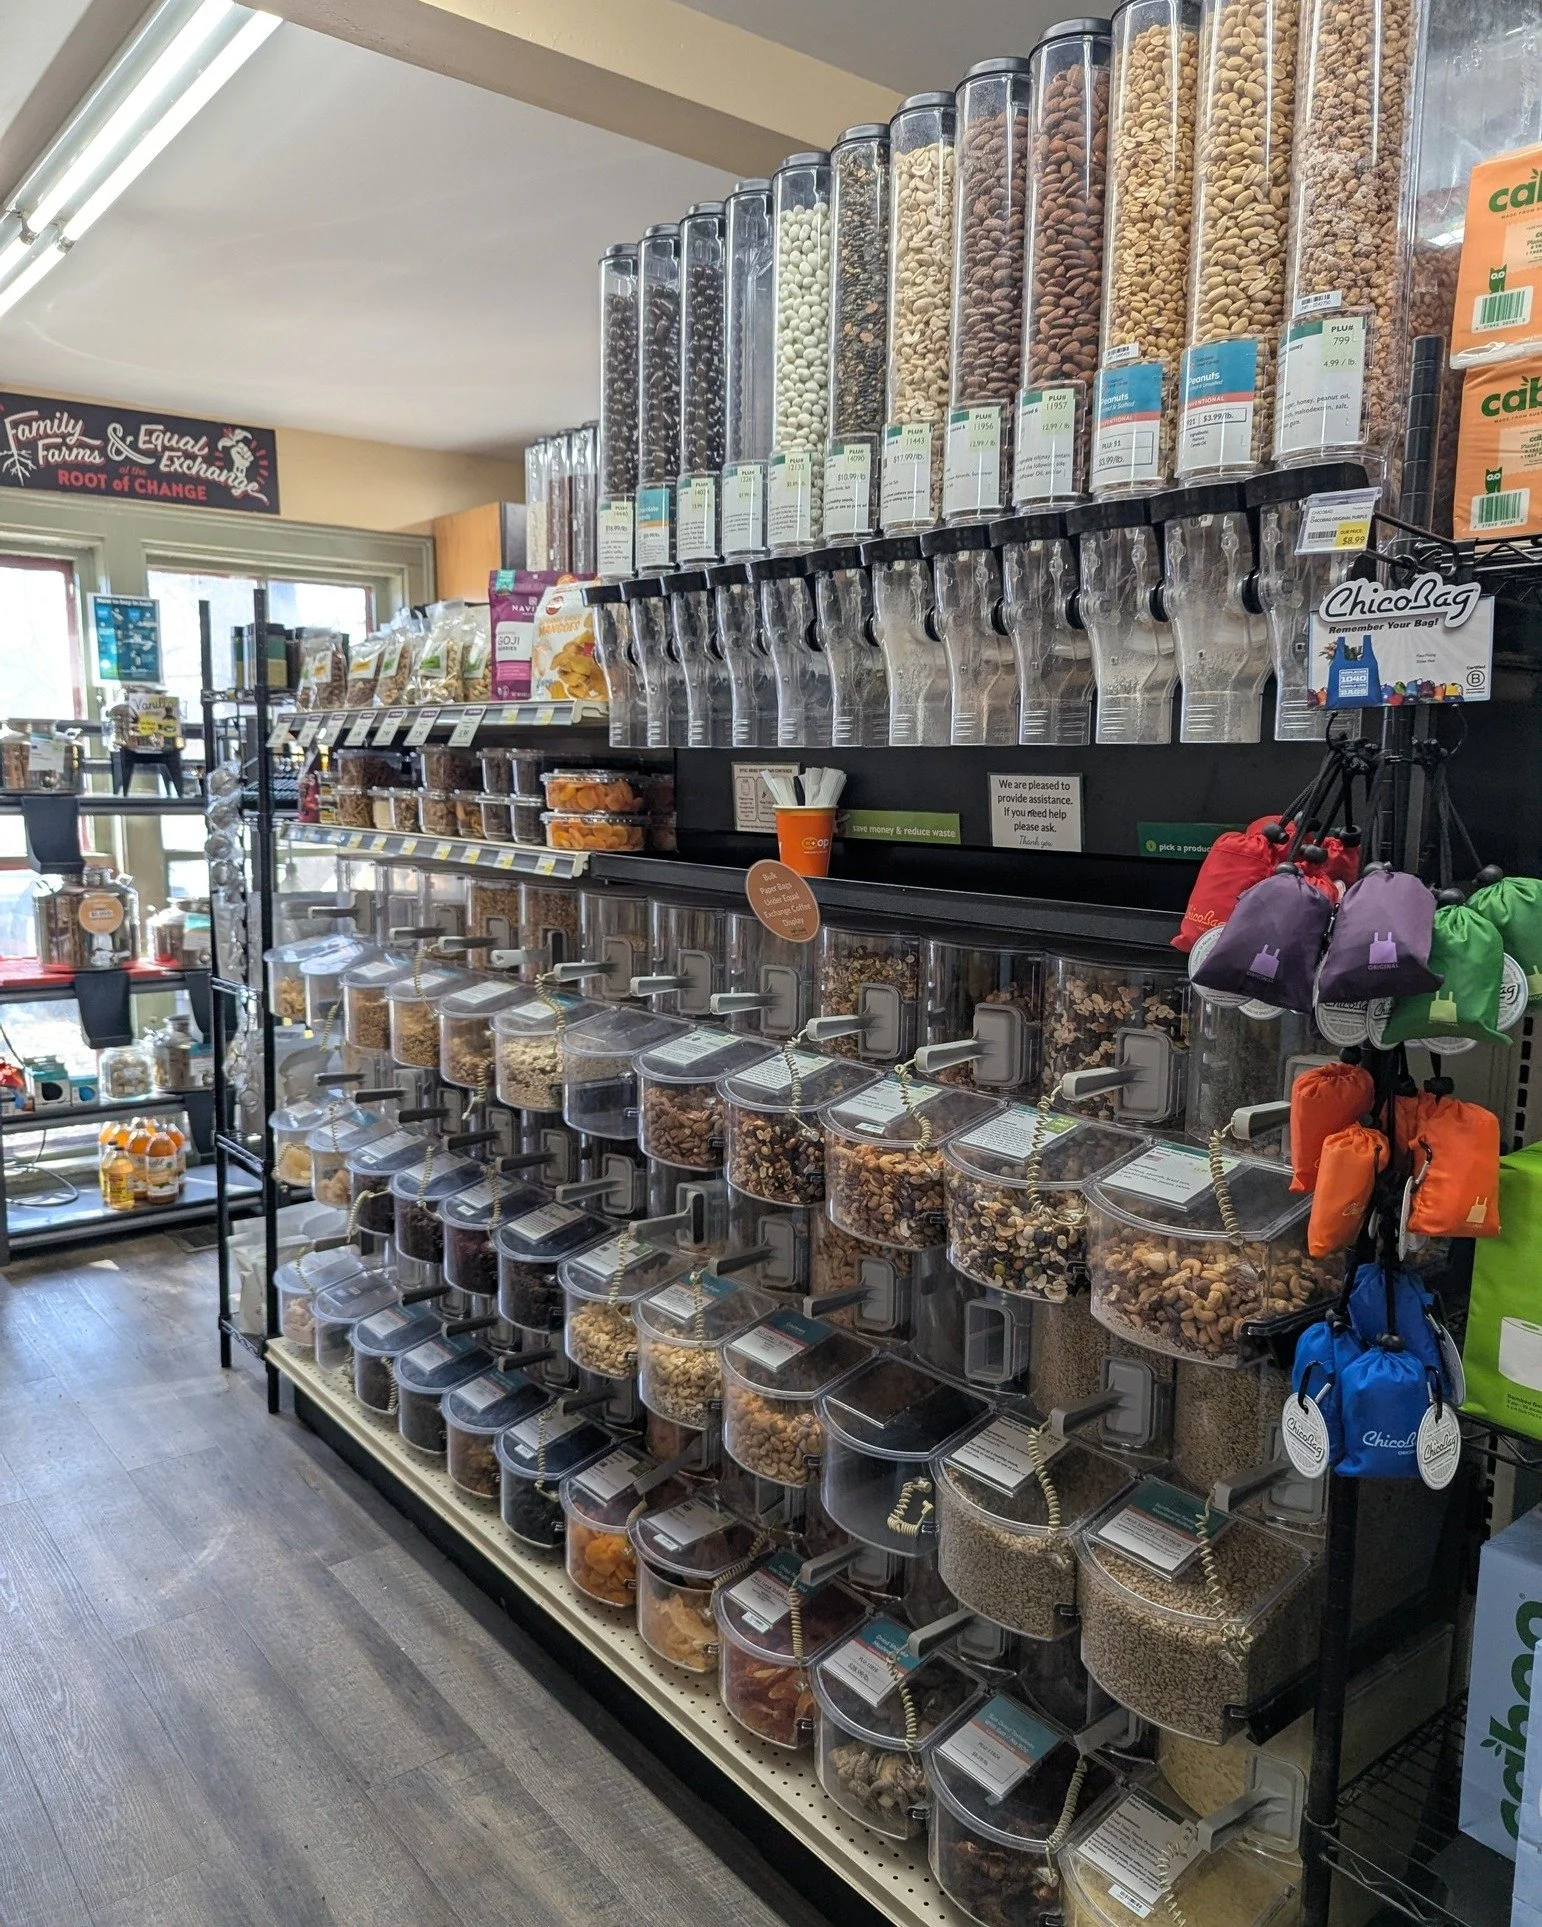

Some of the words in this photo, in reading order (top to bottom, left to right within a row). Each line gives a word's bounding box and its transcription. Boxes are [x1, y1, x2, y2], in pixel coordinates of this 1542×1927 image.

[1489, 172, 1542, 213] ca
[1331, 325, 1354, 333] PLU#
[1333, 336, 1350, 346] 799
[1188, 371, 1220, 384] Peanuts
[1481, 376, 1542, 418] cab
[1046, 402, 1068, 410] 11957
[5, 410, 103, 450] Family
[973, 422, 994, 431] 11956
[107, 423, 155, 465] &
[138, 424, 209, 456] Equal
[906, 437, 925, 446] 11443
[38, 438, 105, 467] Farms
[57, 469, 108, 488] ROOT
[112, 477, 130, 492] of
[135, 477, 208, 500] CHANGE
[159, 451, 269, 506] Exchange
[1342, 536, 1366, 545] $8.99
[1325, 578, 1476, 621] ChicoBag
[1328, 622, 1384, 634] Remember
[1387, 621, 1411, 630] Your
[1413, 618, 1439, 628] Bag!
[498, 635, 520, 645] GOJI
[1340, 675, 1367, 683] 1040
[999, 779, 1013, 789] We
[1014, 781, 1027, 789] are
[1028, 780, 1059, 792] pleased
[1061, 782, 1071, 791] to
[997, 794, 1028, 805] provide
[1029, 795, 1073, 805] assistance.
[1004, 807, 1010, 816] If
[1011, 809, 1026, 819] you
[1027, 808, 1047, 818] need
[1049, 809, 1067, 820] help
[853, 825, 868, 833] save
[869, 825, 896, 836] money
[896, 826, 902, 835] &
[904, 826, 930, 837] reduce
[932, 829, 956, 838] waste
[1014, 822, 1040, 832] please
[1041, 823, 1057, 832] ask.
[1019, 835, 1040, 846] Thank
[1041, 839, 1053, 848] you
[1159, 843, 1176, 852] pick
[763, 872, 777, 882] Bulk
[760, 886, 777, 896] Paper
[777, 882, 793, 893] Bags
[764, 895, 782, 907] Under
[782, 892, 801, 904] Equal
[764, 907, 791, 919] Exchange
[791, 903, 812, 913] Coffee
[782, 917, 805, 928] Display
[1367, 963, 1400, 971] ORIGINAL
[1287, 1417, 1322, 1458] ChicoBag
[1362, 1430, 1418, 1448] ChicoB
[1424, 1432, 1458, 1460] ChicoBag
